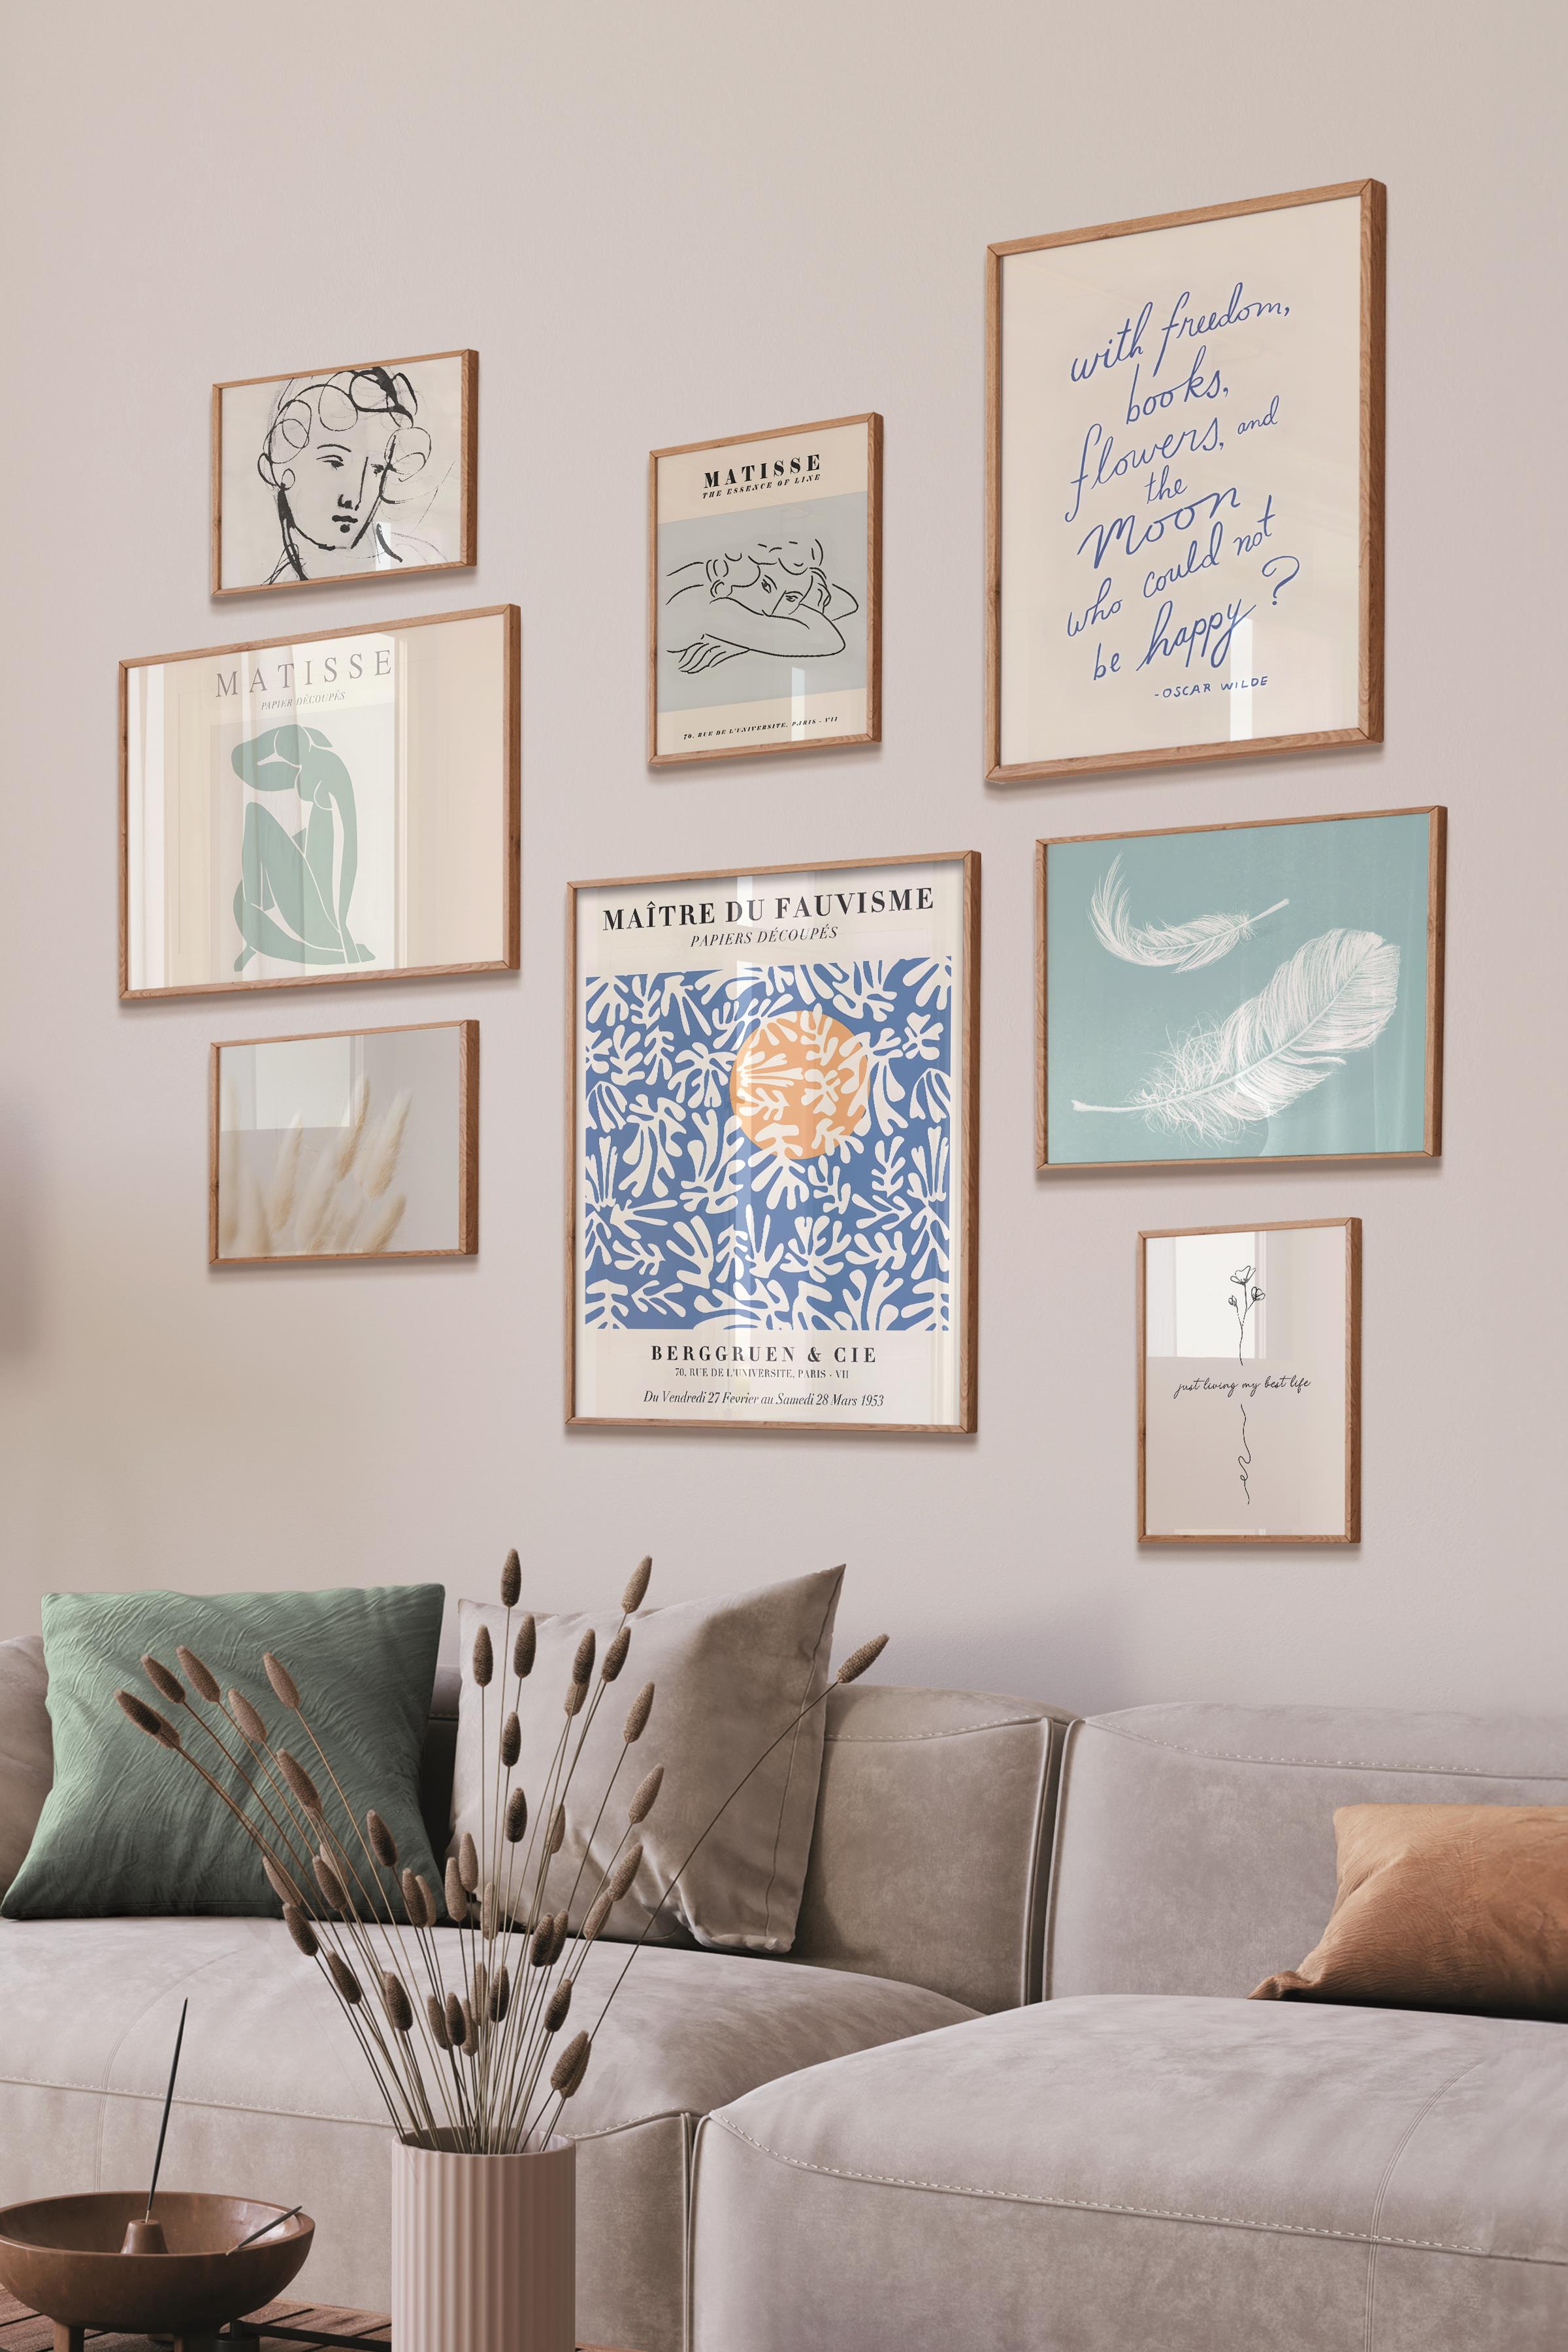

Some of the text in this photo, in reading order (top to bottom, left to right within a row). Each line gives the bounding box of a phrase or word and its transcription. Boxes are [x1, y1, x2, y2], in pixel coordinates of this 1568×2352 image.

[1070, 282, 1290, 382] with freedom,
[1126, 345, 1229, 425] books,
[703, 454, 820, 488] MATISSE
[1064, 395, 1280, 523] flowers, and
[702, 490, 721, 498] THE
[727, 482, 772, 495] ESSENCE
[794, 474, 821, 483] LINE
[1144, 465, 1188, 504] the
[1067, 495, 1276, 637] who could not
[216, 649, 391, 697] MATISSE
[1093, 642, 1121, 681] be
[261, 690, 346, 710] PAPIER DÉCOUPÉS
[1220, 676, 1269, 691] WILDE
[602, 887, 934, 931] MAÎTRE DU FAUVISME
[690, 923, 838, 947] PAPIERS DÉCOUPÉS
[651, 1345, 876, 1363] BERGGRUEN & CIE
[690, 1368, 708, 1377] RUE
[711, 1368, 723, 1377] DE
[798, 1369, 826, 1378] PARIS
[836, 1369, 849, 1379] VII
[1173, 1375, 1312, 1399] just living my best life
[644, 1390, 884, 1407] Du Vendredi 27 Fevrier au Samedi 28 Mars 1953
